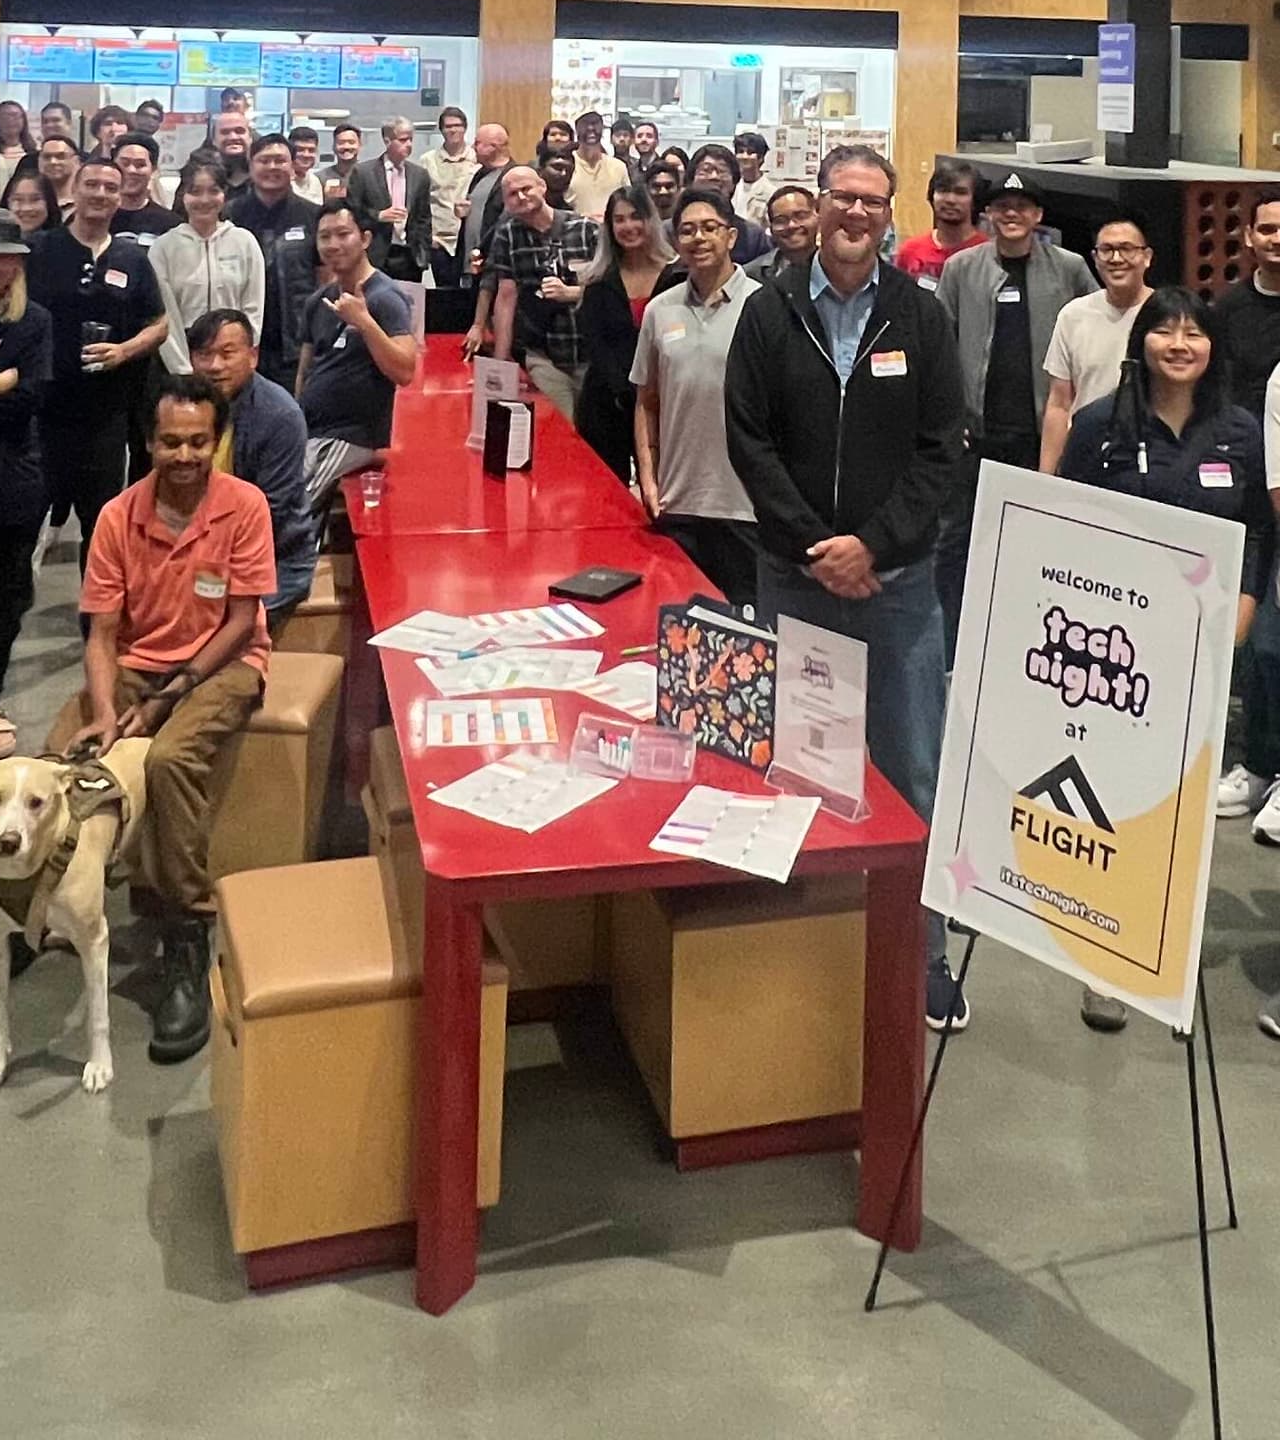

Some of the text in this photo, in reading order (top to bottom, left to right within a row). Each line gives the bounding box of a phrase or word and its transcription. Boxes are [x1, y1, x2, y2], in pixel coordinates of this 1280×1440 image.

[1041, 565, 1149, 610] welcome to
[1044, 607, 1135, 669] tech
[1026, 649, 1149, 717] night!
[1065, 722, 1087, 742] at
[1010, 806, 1117, 872] FLIGHT
[999, 865, 1121, 935] itstechnight.com
